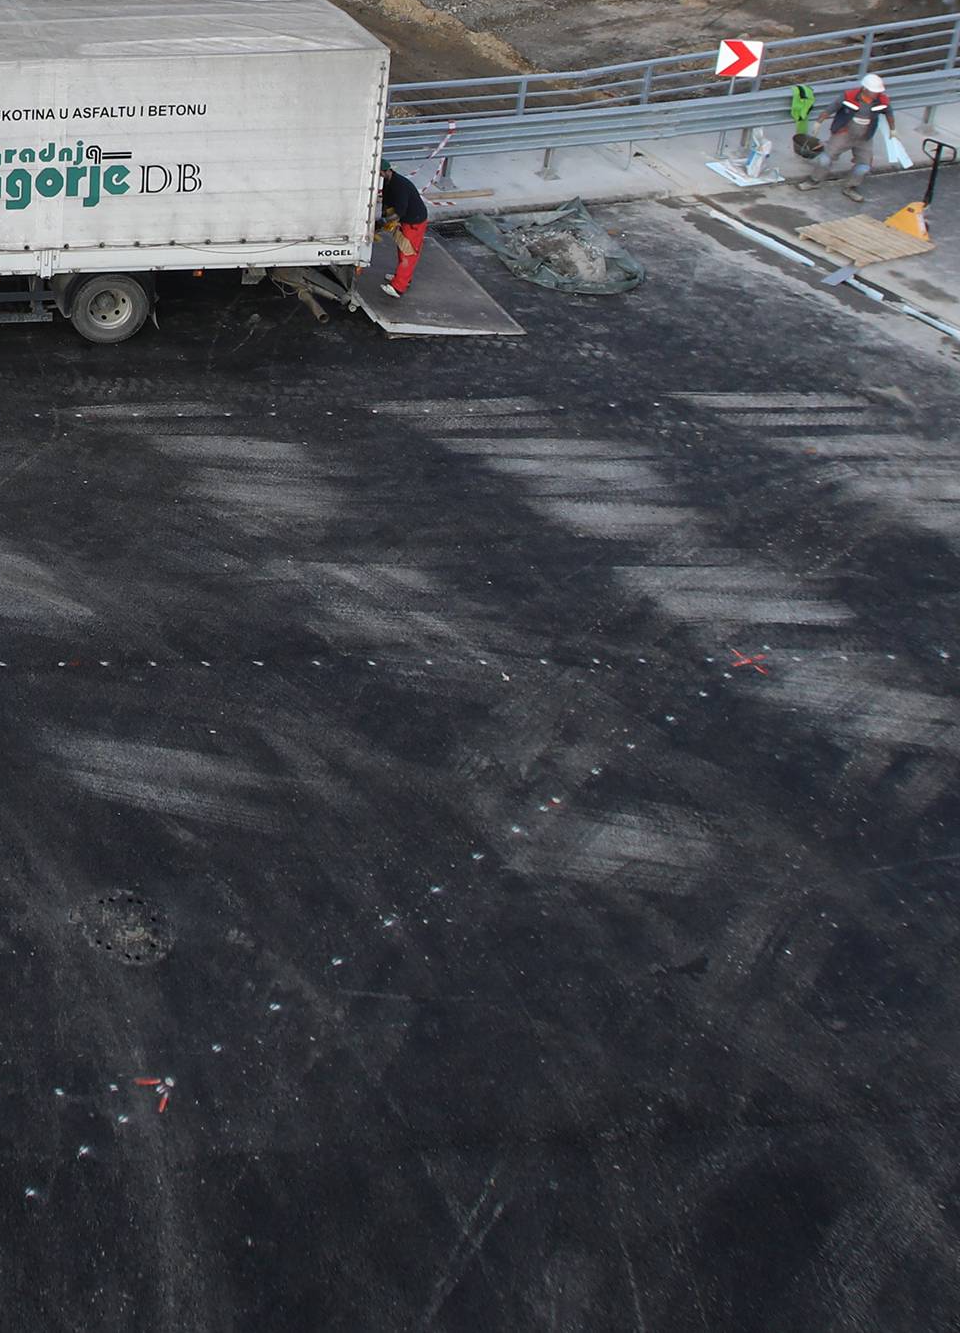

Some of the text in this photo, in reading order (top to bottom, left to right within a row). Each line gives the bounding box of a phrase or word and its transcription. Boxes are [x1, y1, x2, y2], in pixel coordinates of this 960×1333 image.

[60, 108, 69, 120] U
[72, 106, 136, 119] ASFALTU
[140, 105, 144, 117] I
[149, 104, 207, 117] BETONU
[139, 163, 203, 194] DB
